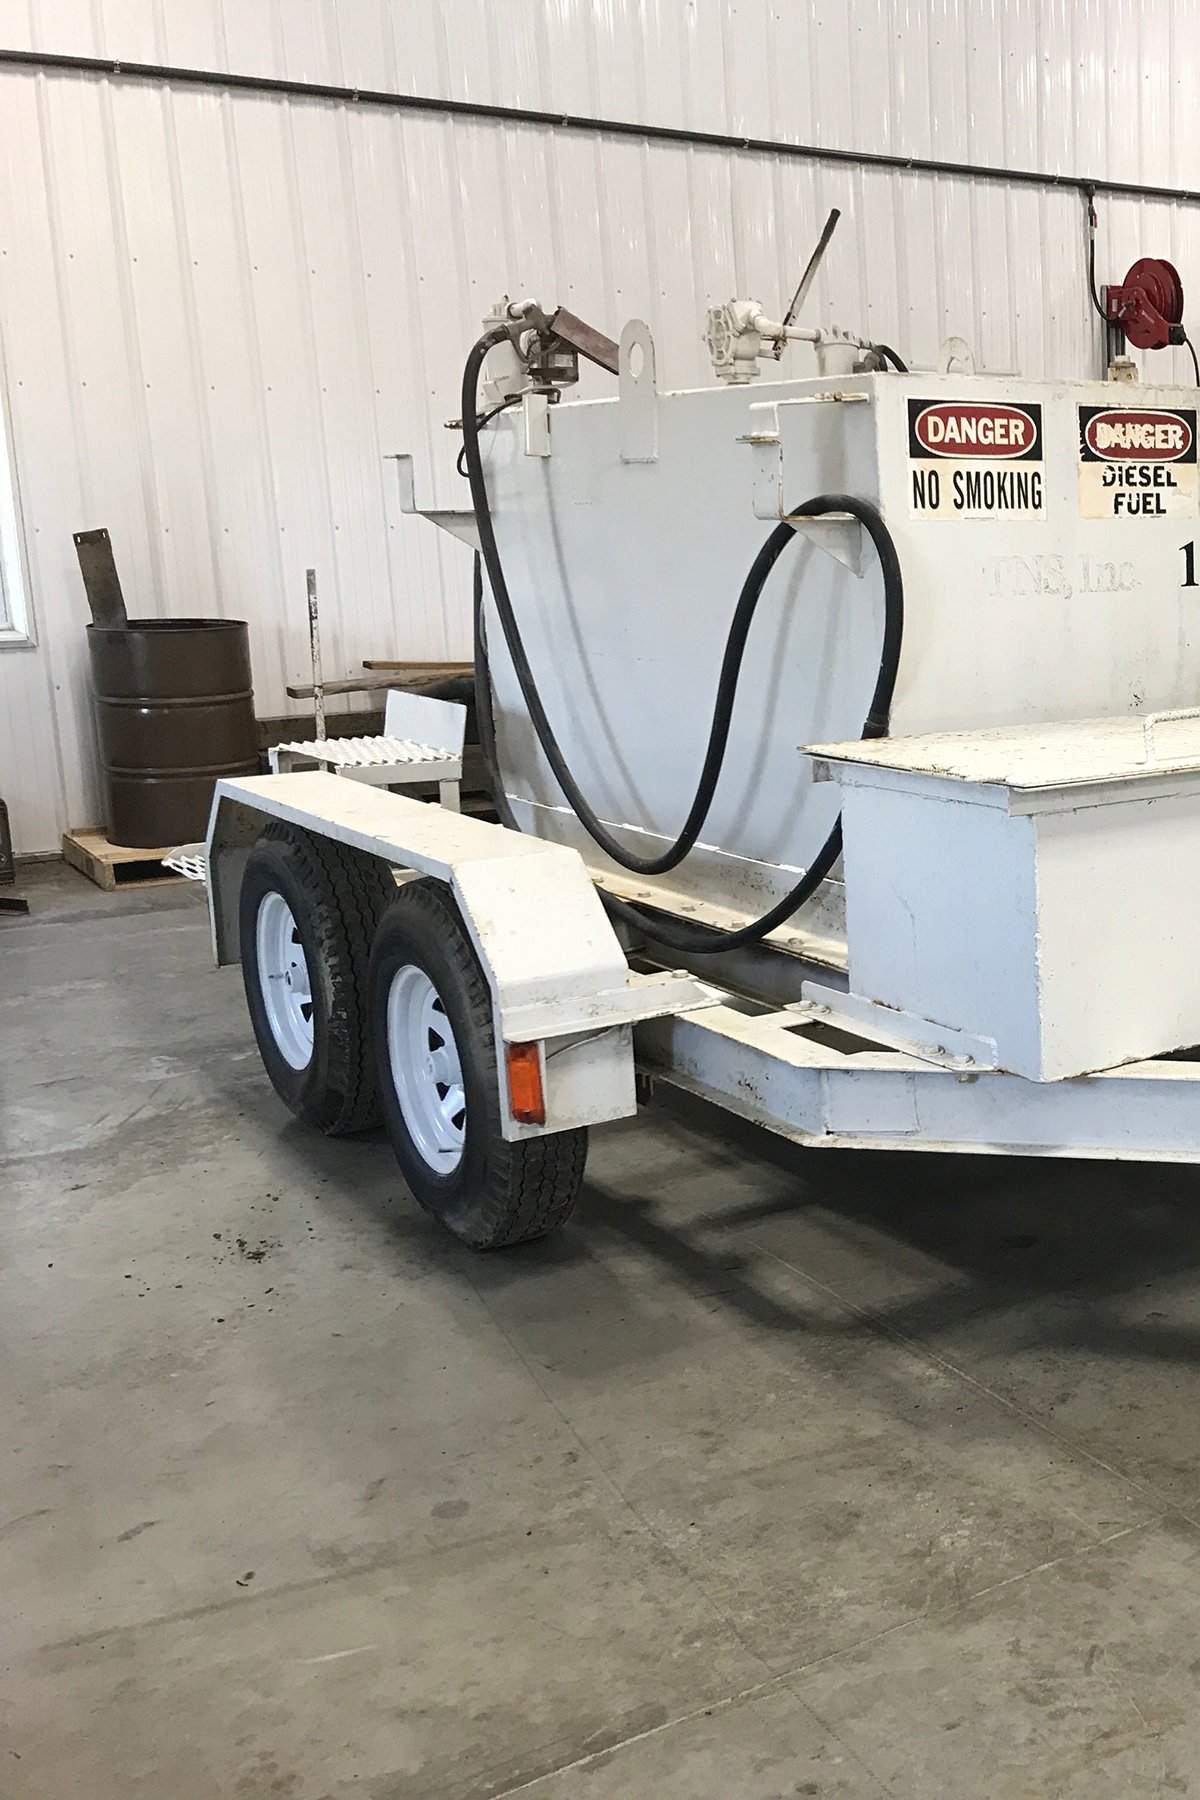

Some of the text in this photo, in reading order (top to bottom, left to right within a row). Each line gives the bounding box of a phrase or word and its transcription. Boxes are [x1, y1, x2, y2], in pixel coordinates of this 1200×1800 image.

[927, 415, 1025, 445] DANGER
[1095, 422, 1184, 449] DANGER
[912, 469, 1042, 510] NO SMOKING
[1102, 465, 1177, 487] DIESEL
[1114, 493, 1167, 515] FUEL
[1178, 541, 1199, 588] 1
